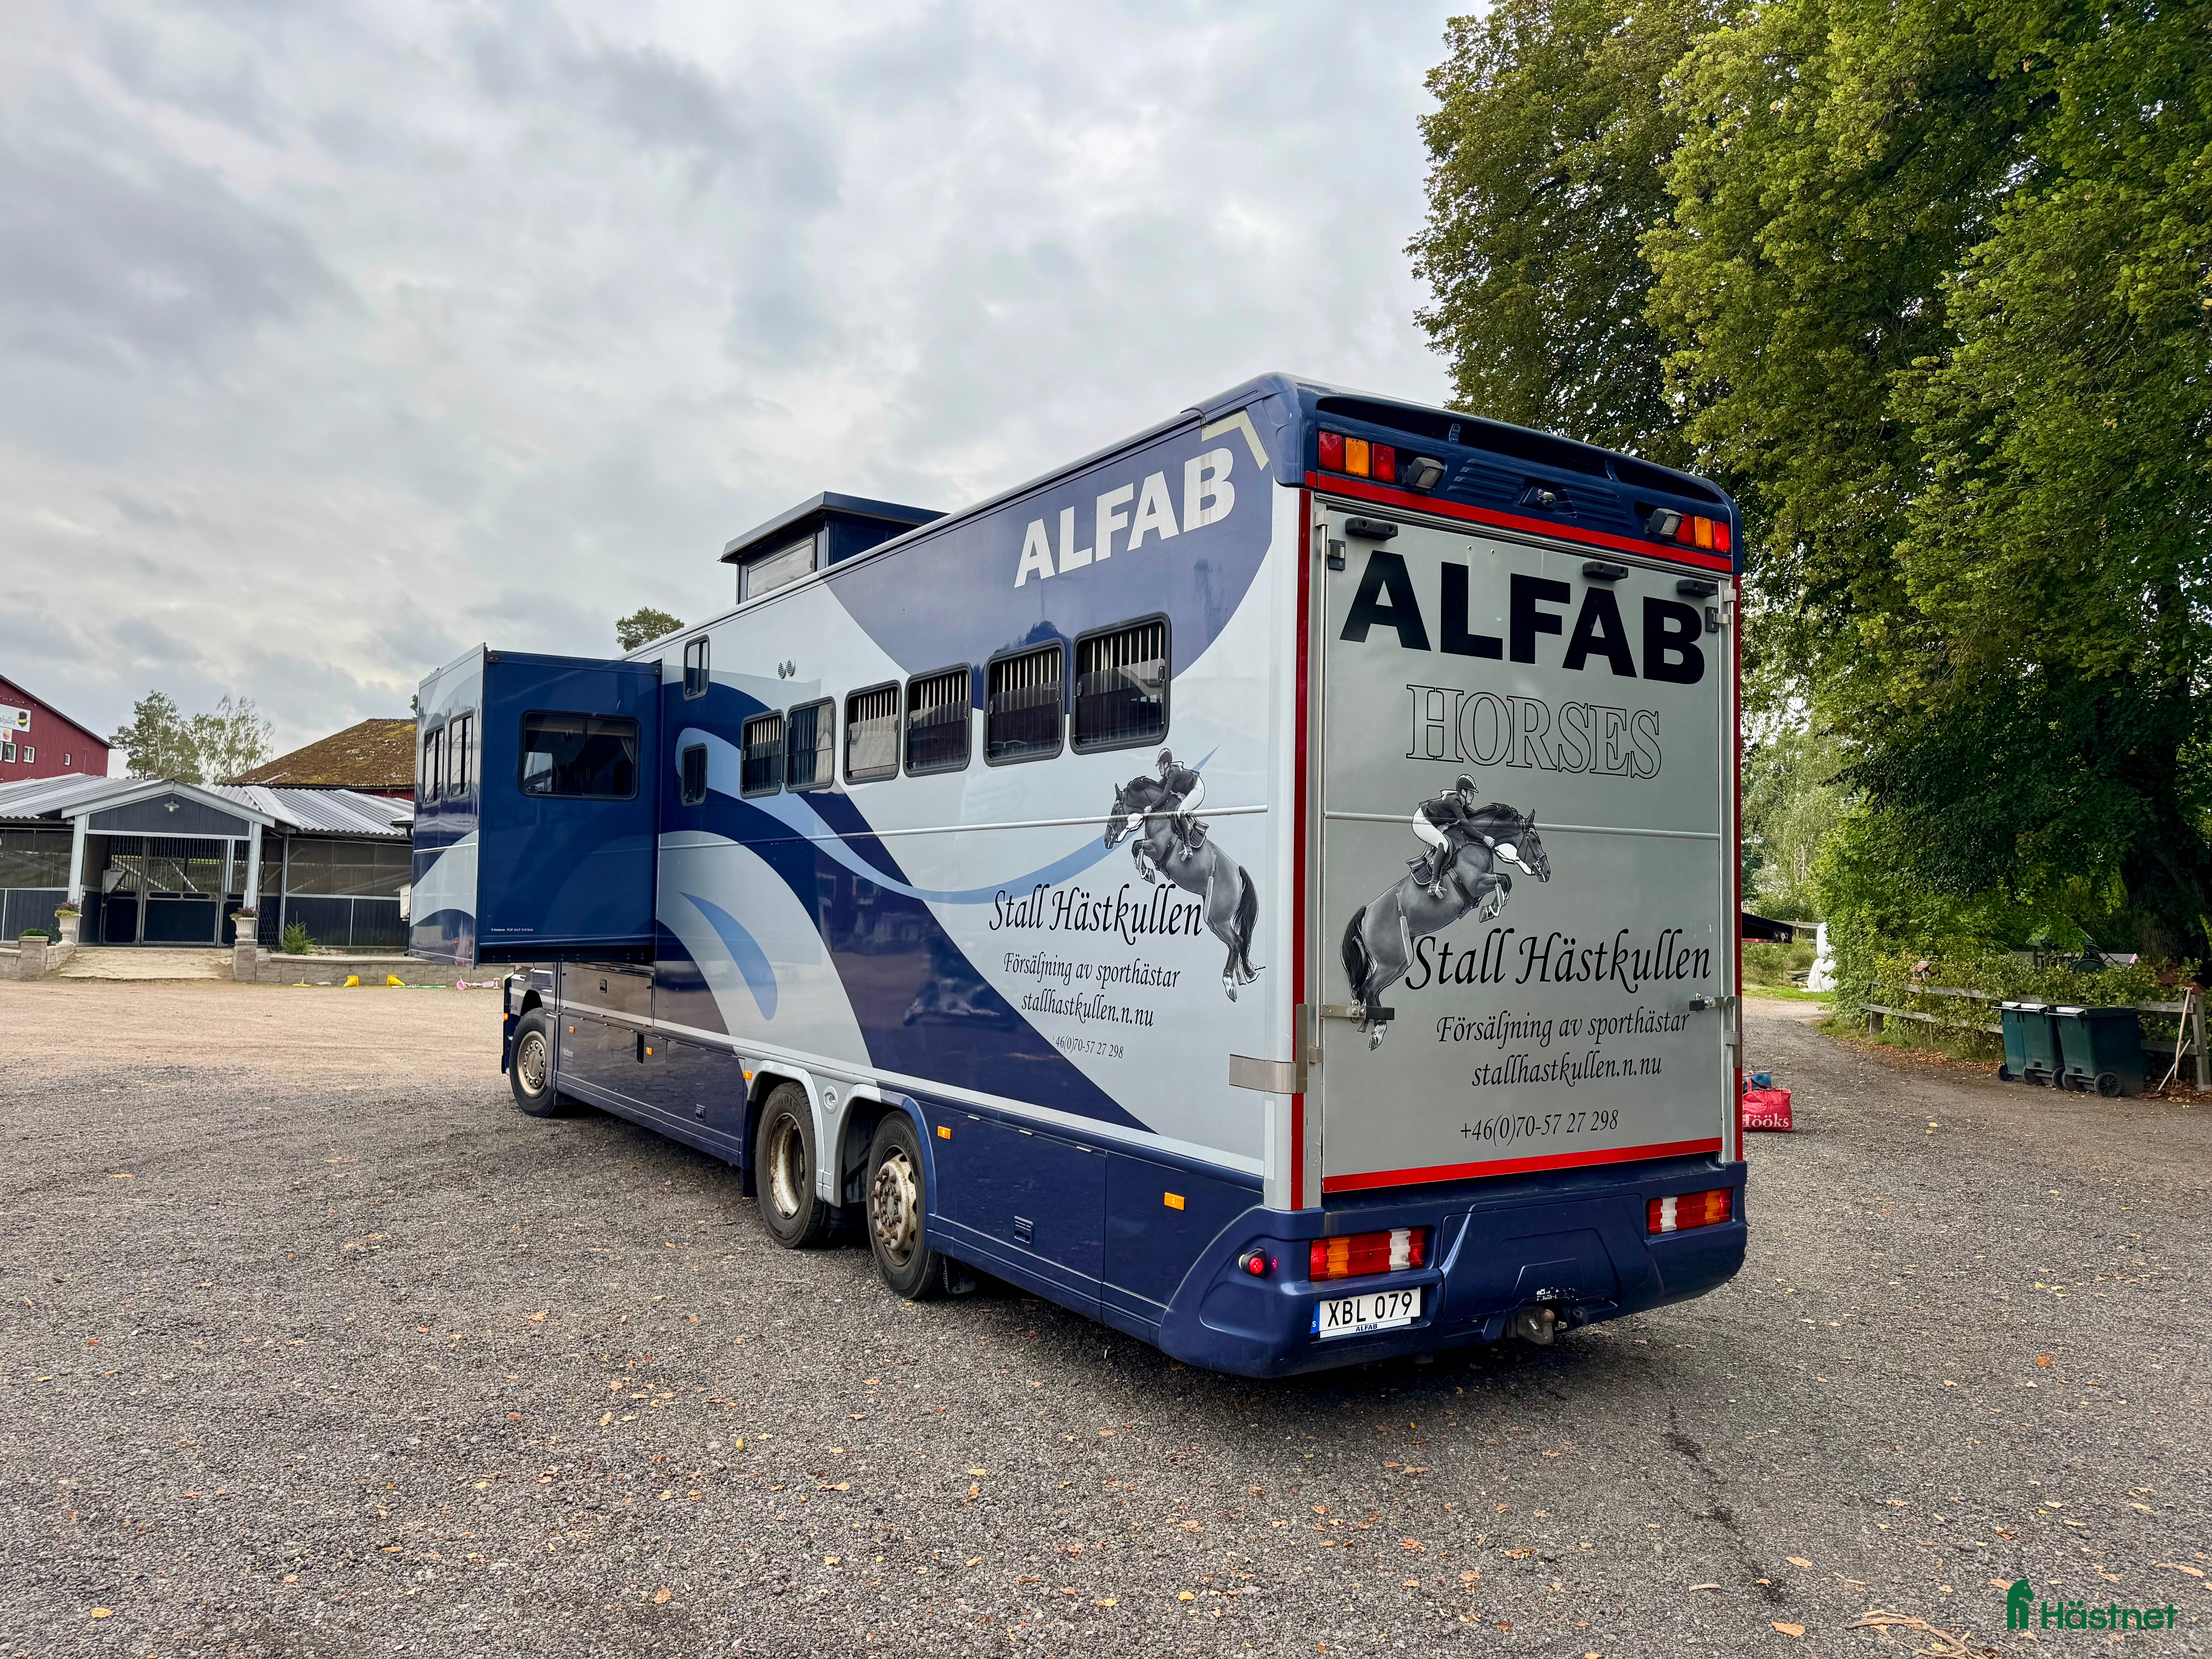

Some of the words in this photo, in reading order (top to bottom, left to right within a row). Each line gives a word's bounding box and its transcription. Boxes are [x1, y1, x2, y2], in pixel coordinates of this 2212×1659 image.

[1014, 448, 1235, 588] ALFAB
[1340, 550, 1704, 685] ALFAB
[1406, 684, 1662, 779] HORSES
[989, 884, 1050, 930] Stall
[1049, 884, 1202, 945] Hästkullen
[1004, 951, 1072, 986] Försäljning
[1076, 963, 1092, 980] av
[1096, 958, 1180, 989] sporthästar
[1405, 928, 1515, 990] Stall
[1515, 928, 1711, 993] Hästkullen
[1022, 989, 1153, 1026] stallhastkullen.n.nu
[1053, 1035, 1095, 1054] 46(0)70-57
[1097, 1042, 1107, 1055] 27
[1108, 1044, 1123, 1058] 298
[1437, 1010, 1552, 1049] Försäljning
[1559, 1019, 1582, 1037] av
[1588, 1006, 1690, 1044] sporthästar
[1472, 1050, 1662, 1087] stallhastkullen.n.nu
[1460, 1114, 1562, 1147] +46(0)70-57
[1566, 1112, 1586, 1133] 27
[1590, 1109, 1618, 1131] 298
[1328, 1299, 1366, 1327] XBL
[1375, 1292, 1412, 1319] 079
[1355, 1324, 1377, 1332] ALFAB
